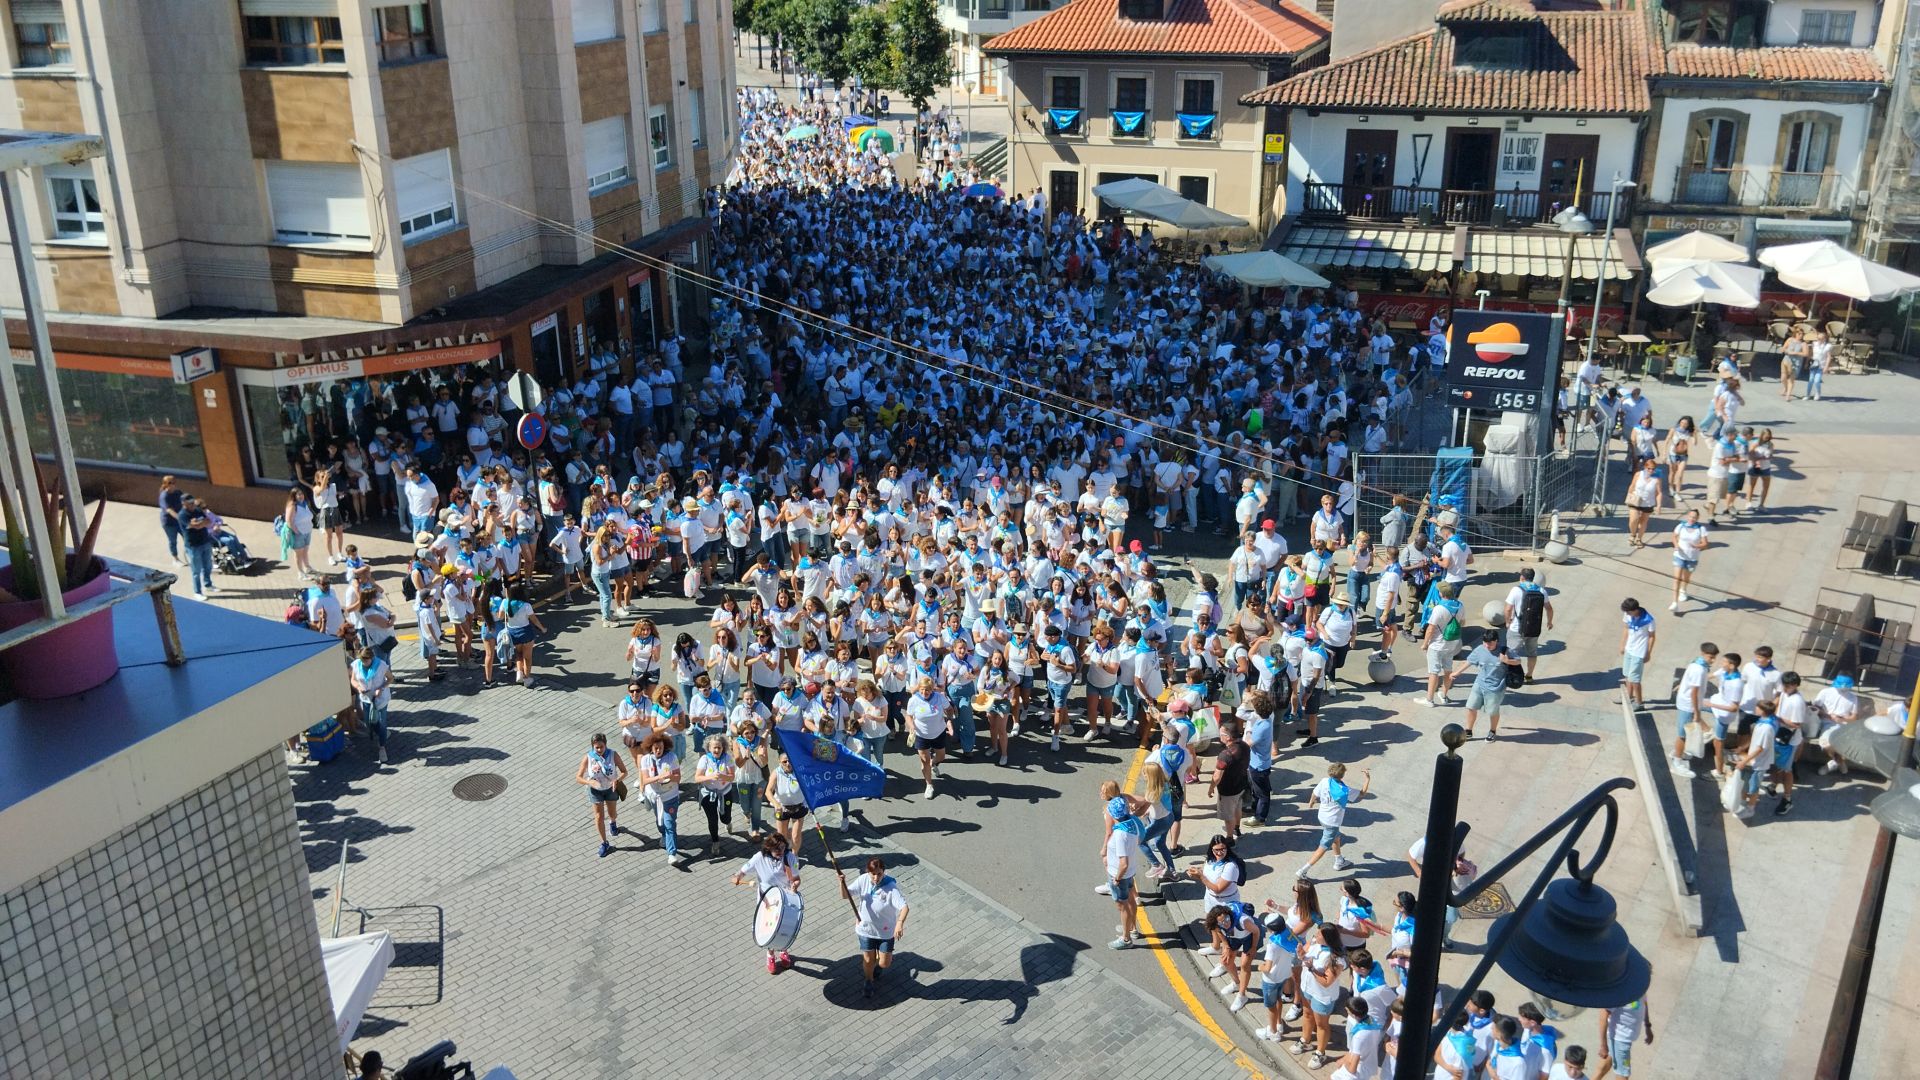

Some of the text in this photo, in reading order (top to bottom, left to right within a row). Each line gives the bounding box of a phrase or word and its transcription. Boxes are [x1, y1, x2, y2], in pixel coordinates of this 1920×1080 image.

[1502, 156, 1514, 171] DEL
[394, 354, 434, 365] COMERCIAL
[287, 362, 350, 378] OPTIMUS
[1463, 366, 1526, 380] REPSOL
[834, 785, 858, 794] Siero
